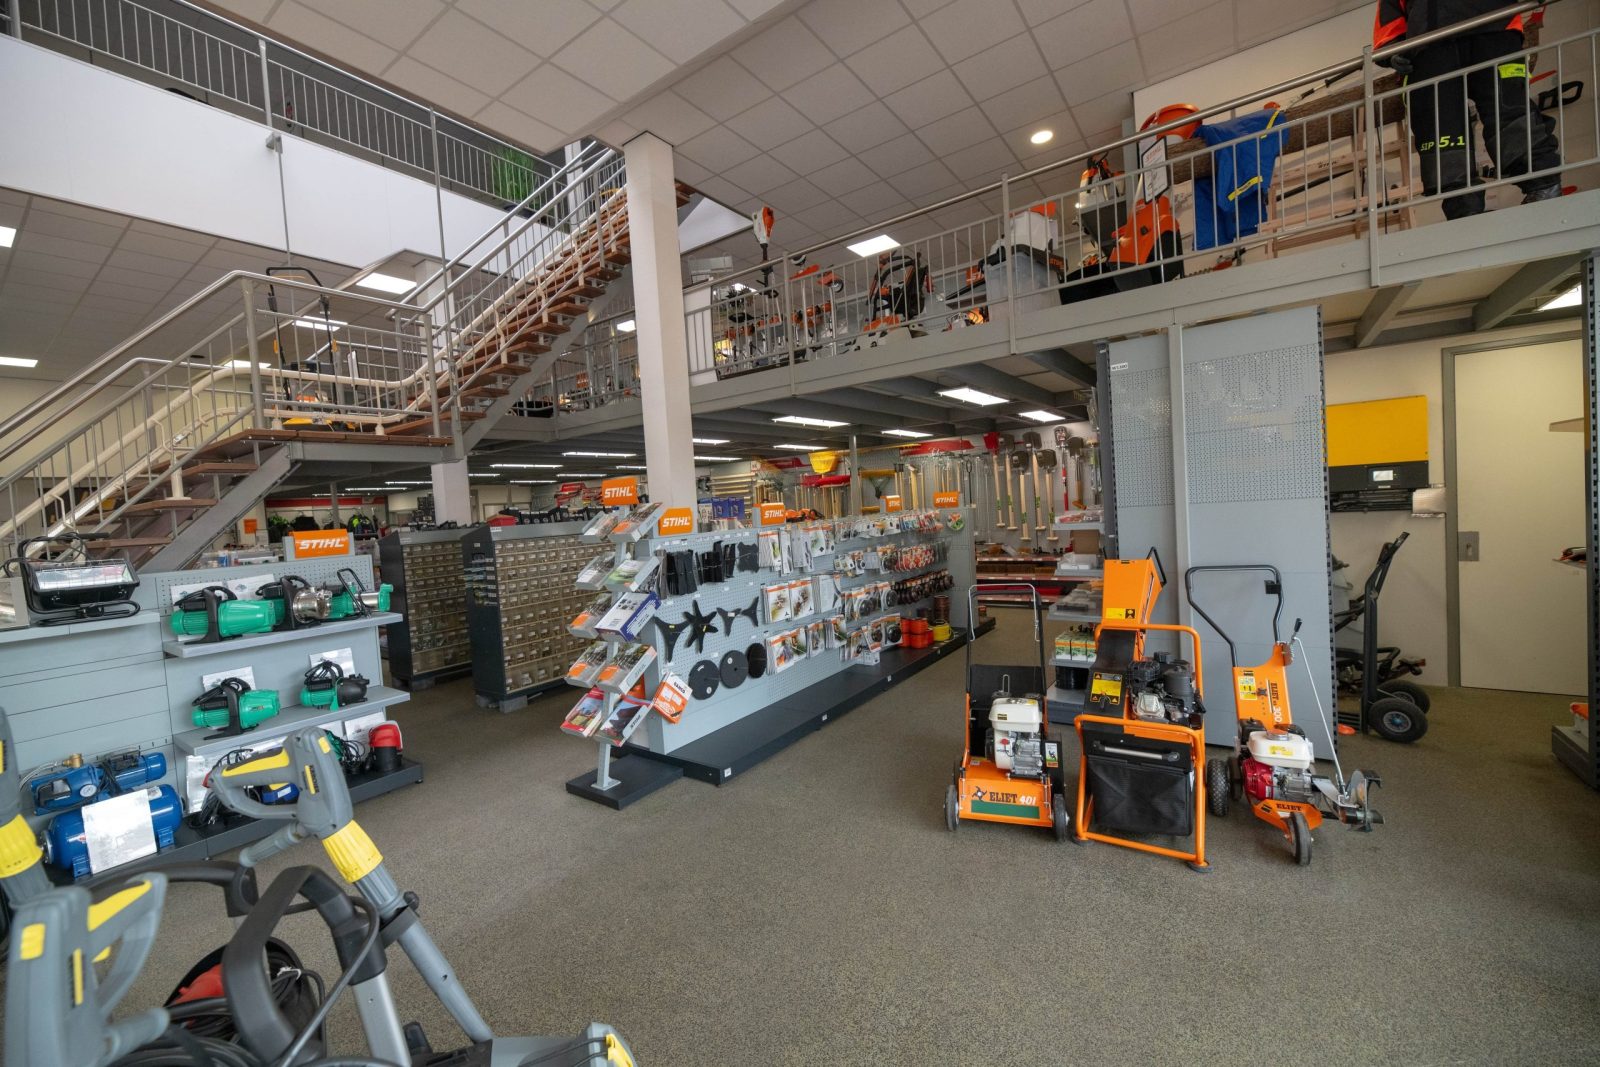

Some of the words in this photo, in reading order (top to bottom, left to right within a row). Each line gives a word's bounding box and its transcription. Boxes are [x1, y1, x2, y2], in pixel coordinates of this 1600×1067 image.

[1420, 141, 1435, 152] SIP
[1438, 135, 1466, 148] 5.1
[604, 486, 633, 498] STIHL
[764, 509, 784, 518] STIHL
[662, 516, 690, 528] STIHL
[299, 538, 344, 550] STIHL
[989, 791, 1018, 803] ELIET
[1276, 803, 1302, 811] ELIET
